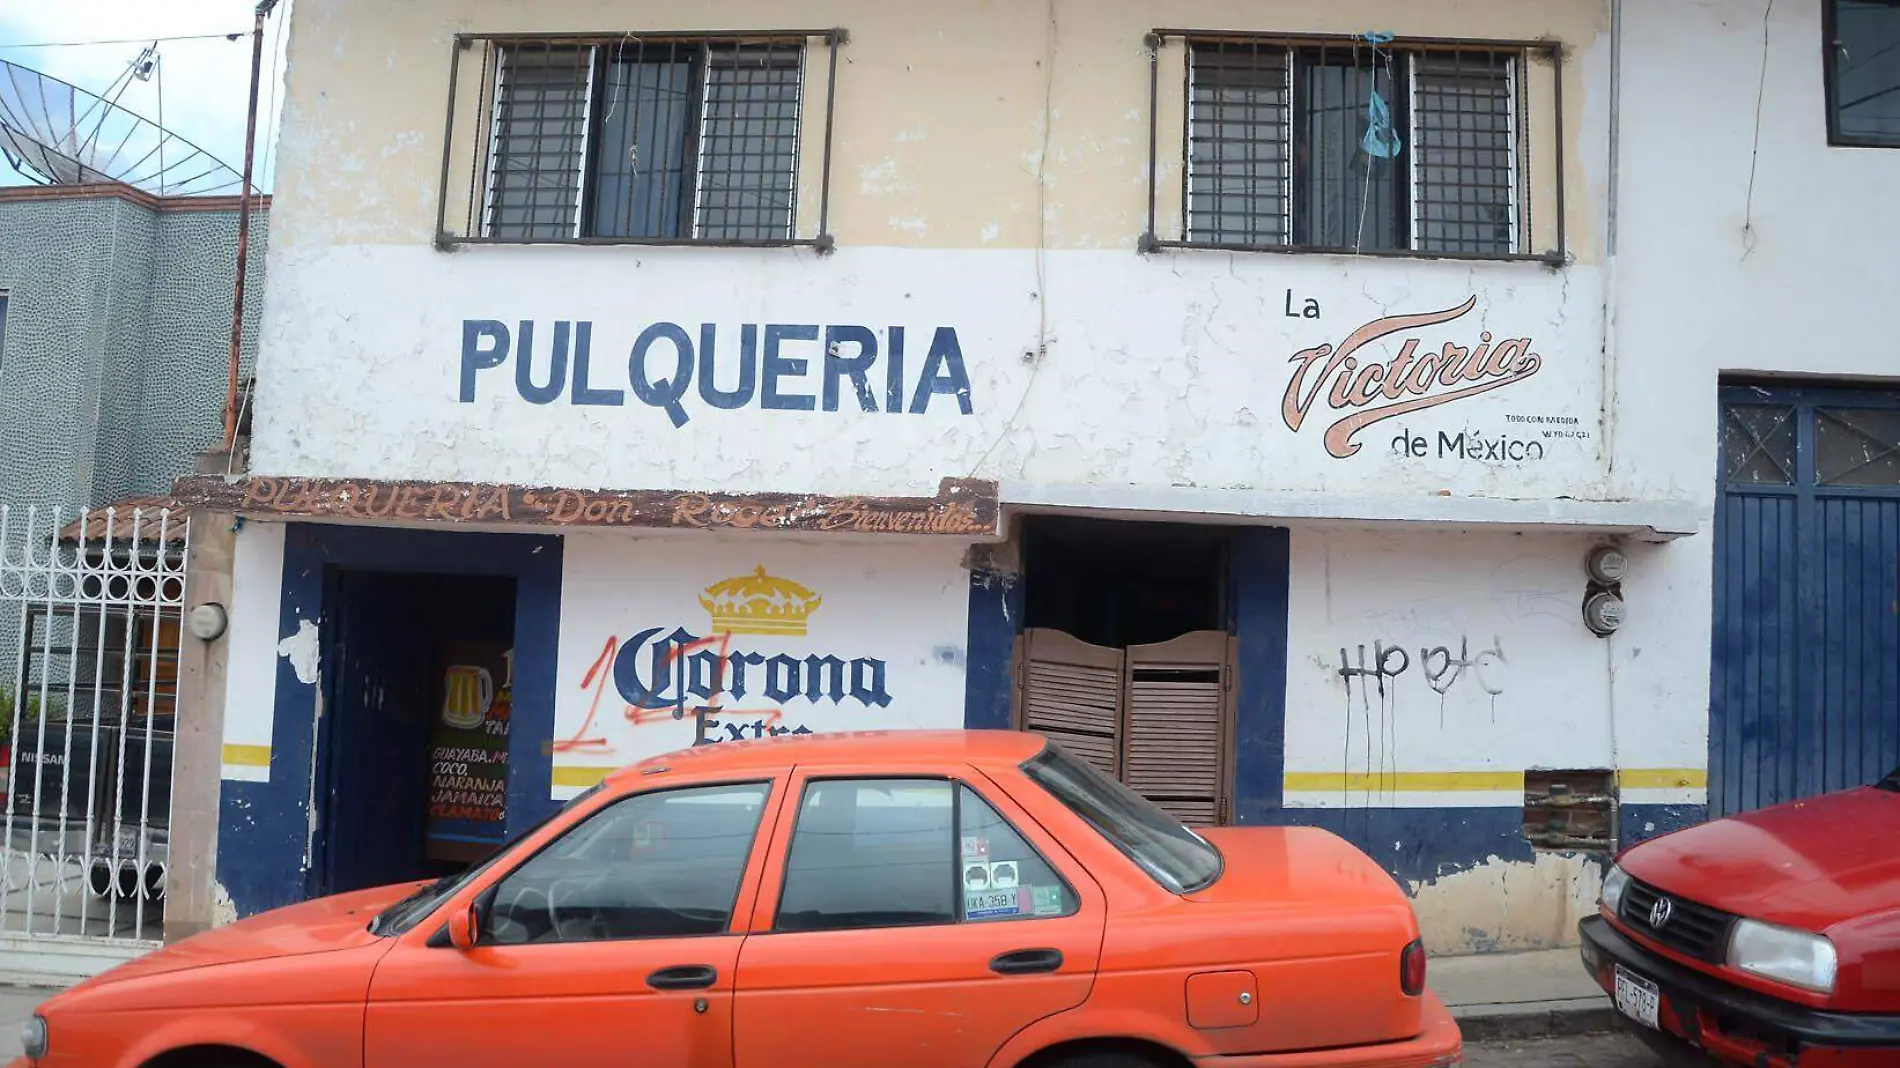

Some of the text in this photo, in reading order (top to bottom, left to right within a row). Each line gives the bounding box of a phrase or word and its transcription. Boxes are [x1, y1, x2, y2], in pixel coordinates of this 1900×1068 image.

[1285, 289, 1320, 319] La
[459, 319, 974, 429] PULQUERIA
[1281, 294, 1542, 459] Victoria
[1391, 427, 1543, 461] de México
[243, 476, 511, 521] PULQUERIA
[613, 626, 893, 720] Corona
